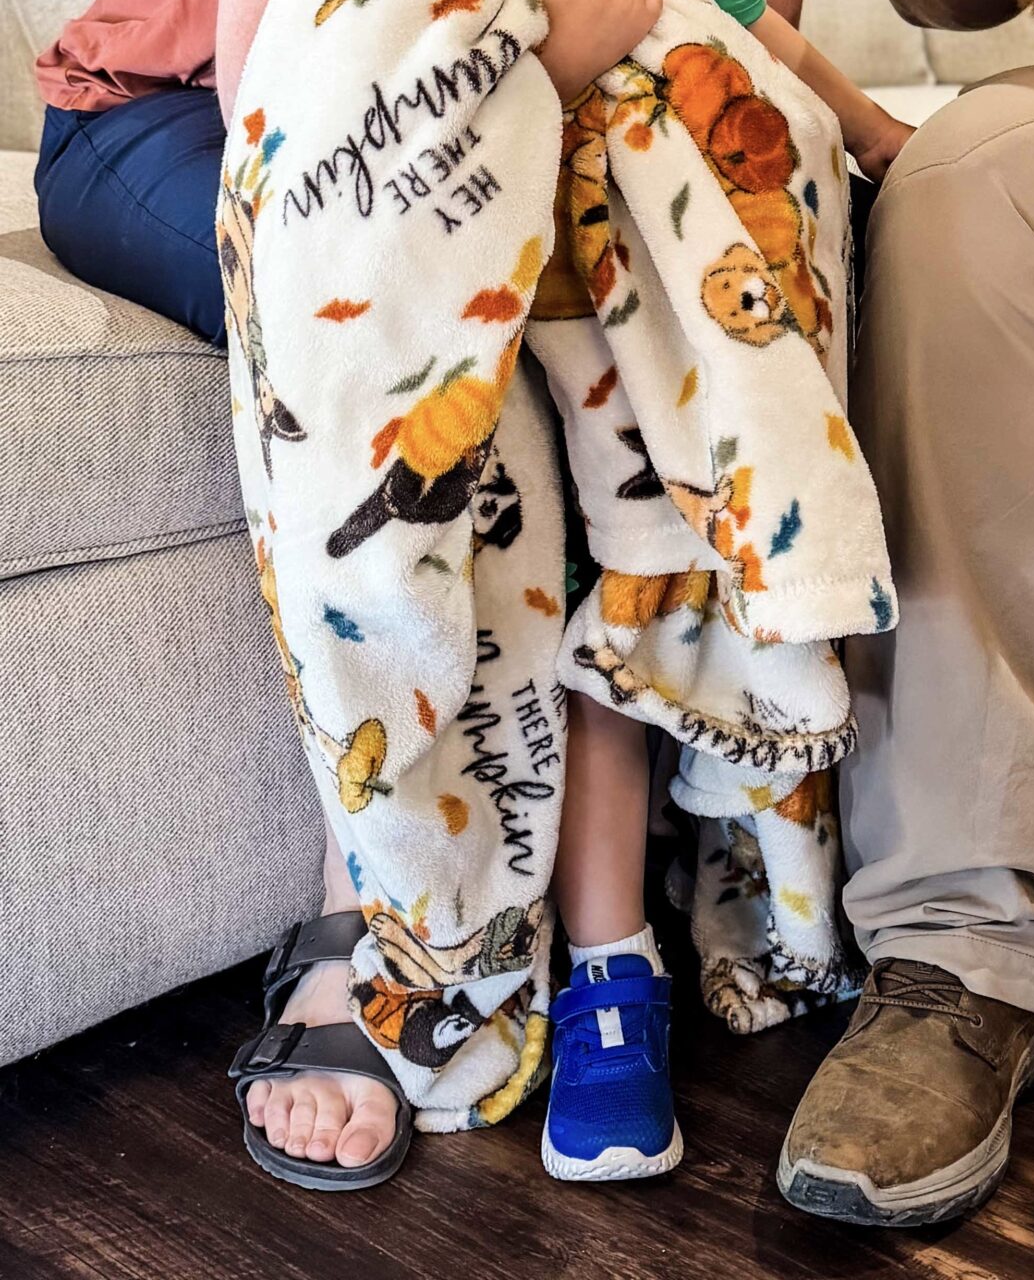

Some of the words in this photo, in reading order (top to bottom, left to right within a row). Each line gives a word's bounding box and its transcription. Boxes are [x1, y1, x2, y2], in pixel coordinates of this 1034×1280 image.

[382, 124, 482, 215] THERE
[433, 161, 502, 234] HEY
[511, 677, 561, 775] THERE
